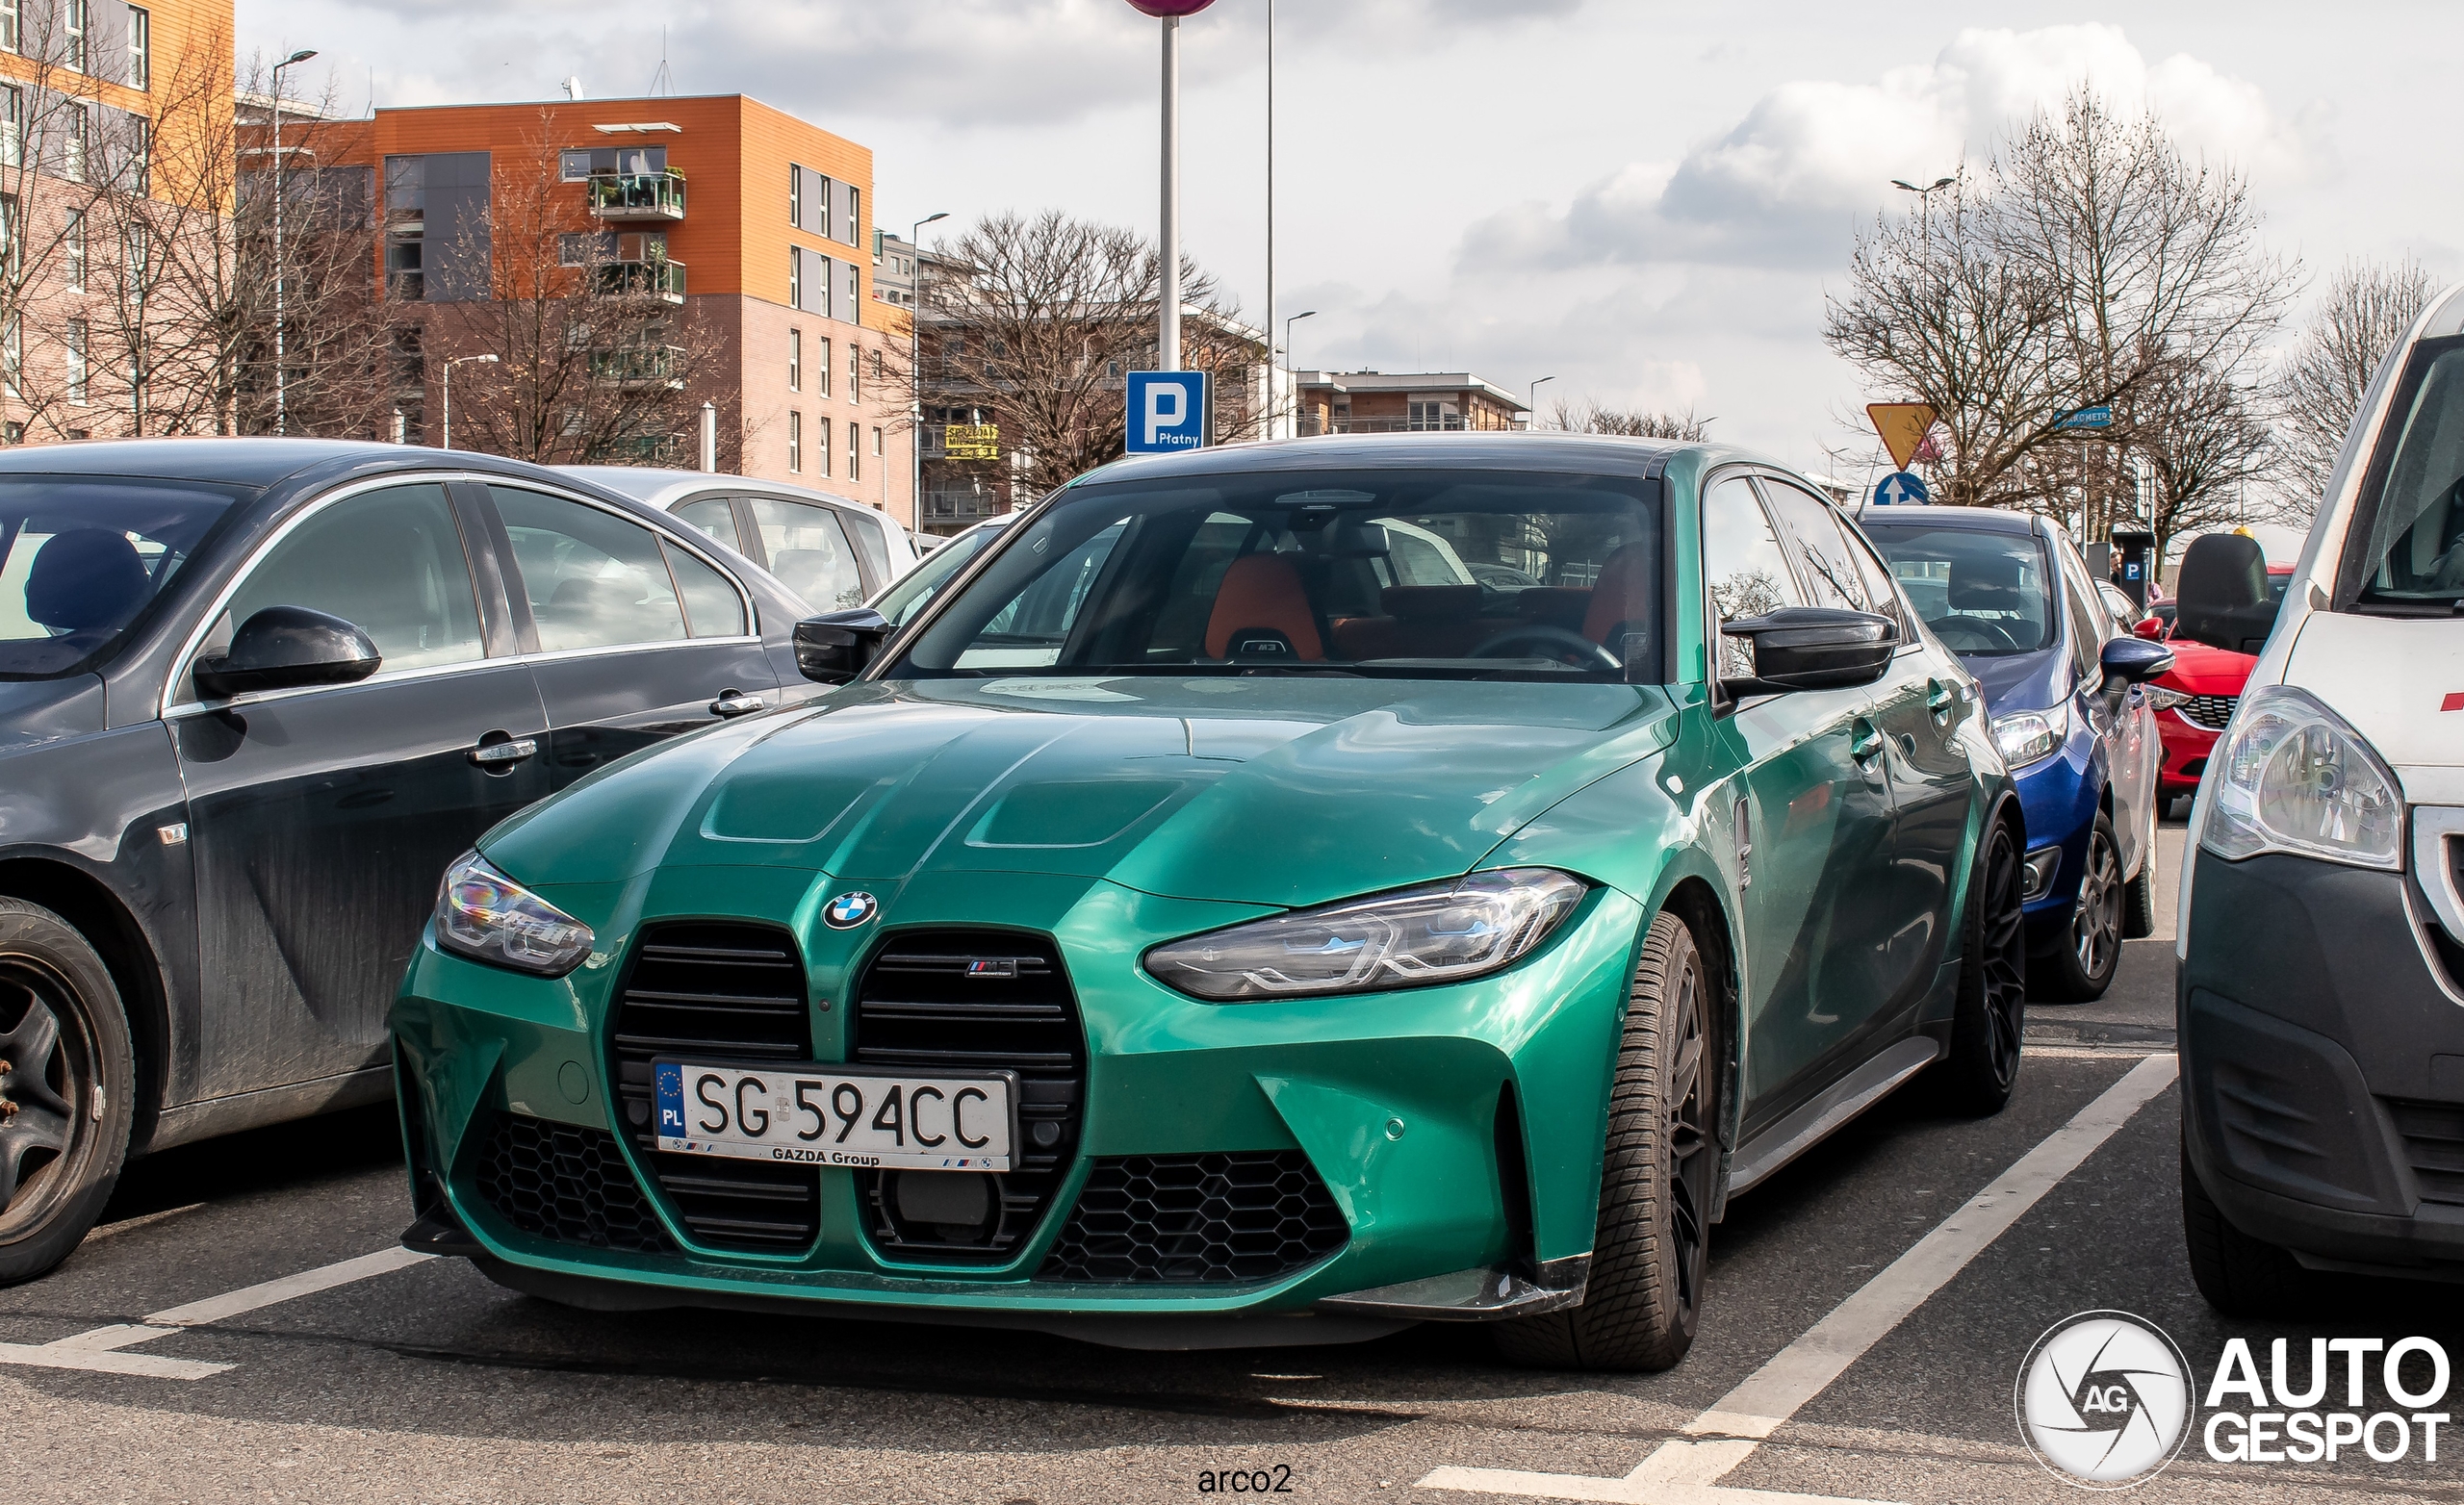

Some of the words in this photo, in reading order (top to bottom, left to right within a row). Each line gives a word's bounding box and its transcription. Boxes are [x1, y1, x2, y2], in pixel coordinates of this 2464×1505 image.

[1144, 382, 1188, 444] P
[1159, 432, 1199, 447] Płatny
[2128, 564, 2139, 577] P
[662, 1109, 682, 1127] PL
[695, 1072, 770, 1138] SG
[794, 1079, 990, 1150] 594CC
[772, 1148, 827, 1163] GAZDA
[832, 1152, 881, 1167] Group
